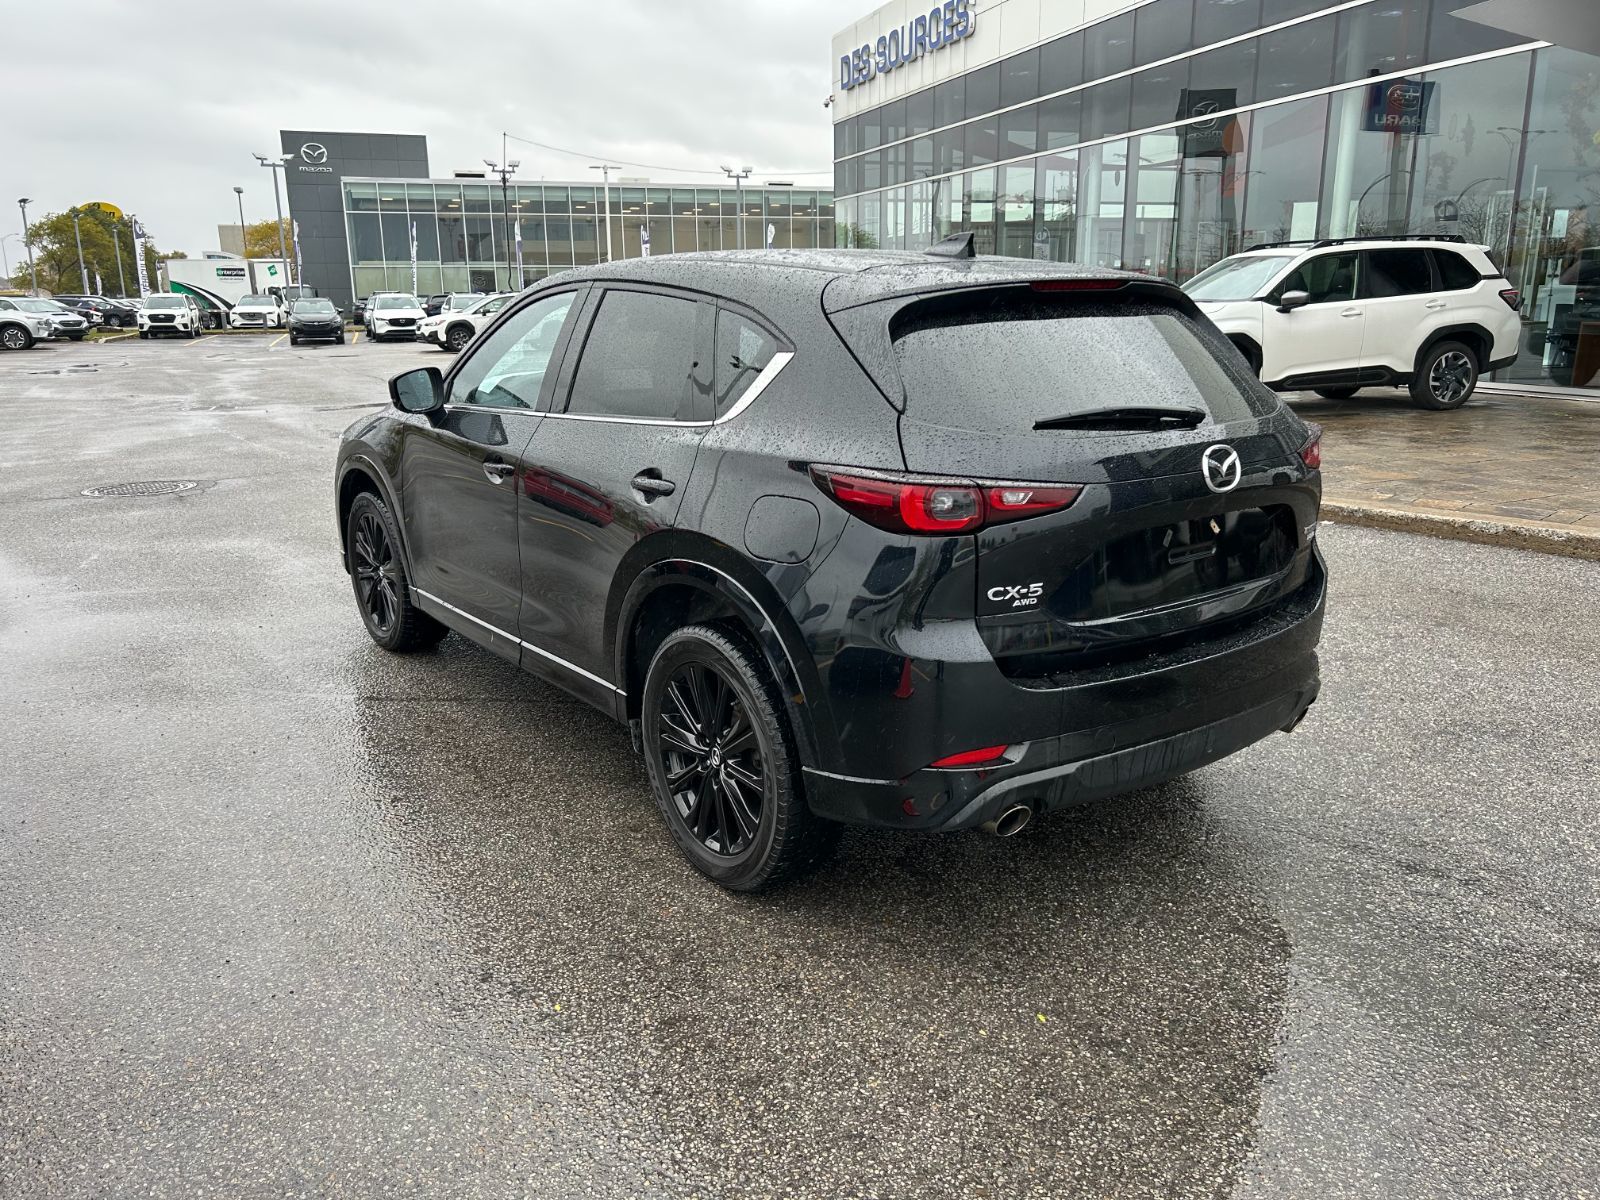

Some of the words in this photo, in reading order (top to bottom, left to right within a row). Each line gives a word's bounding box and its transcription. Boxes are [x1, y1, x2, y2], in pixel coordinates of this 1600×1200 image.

[841, 44, 873, 90] DES
[877, 0, 974, 73] SOURCES
[987, 582, 1044, 601] CX-5
[1012, 597, 1038, 607] AWD
